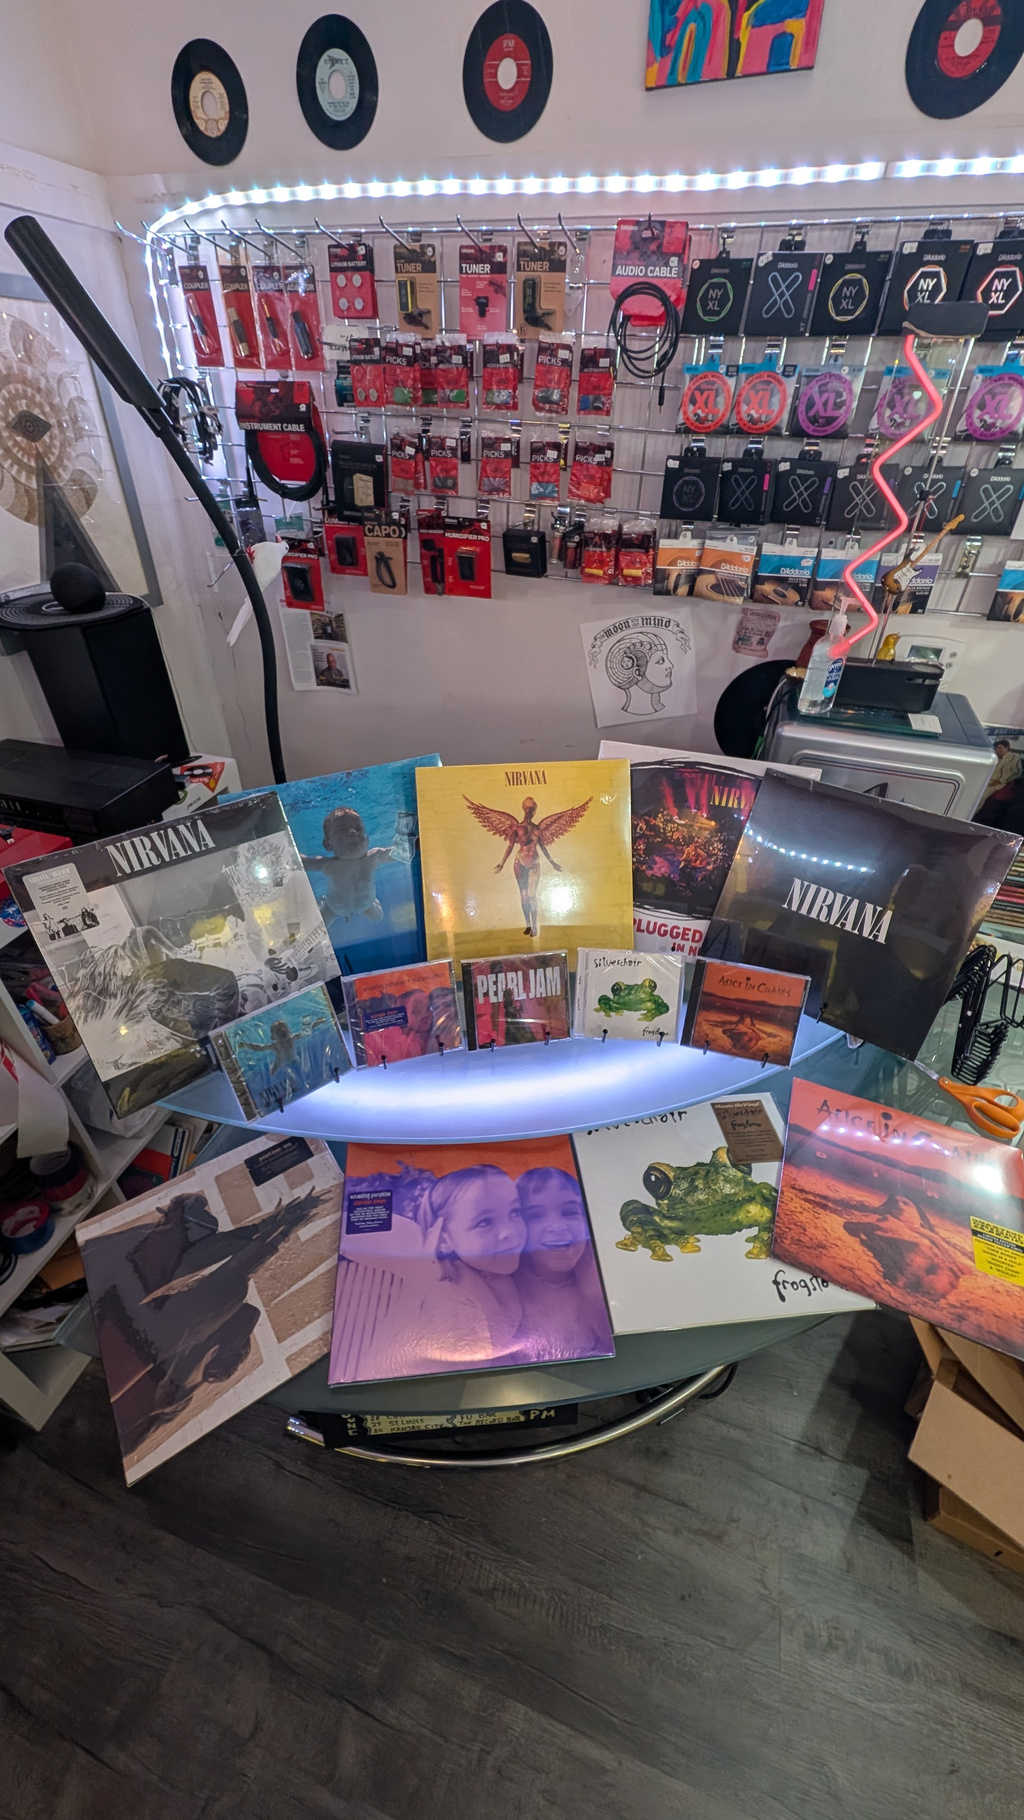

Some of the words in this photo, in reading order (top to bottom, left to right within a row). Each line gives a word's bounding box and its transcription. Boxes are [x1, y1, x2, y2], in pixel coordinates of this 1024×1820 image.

[396, 262, 422, 273] TUNER
[461, 264, 491, 273] TUNER
[520, 261, 550, 272] TUNER
[615, 265, 646, 276] AUDIO
[647, 266, 679, 278] CABLE
[184, 282, 209, 290] COUPLER
[224, 282, 248, 290] COUPLER
[918, 278, 938, 291] NY
[992, 278, 1012, 291] NY
[708, 288, 724, 299] NY
[842, 286, 859, 297] NY
[915, 292, 931, 303] XL
[988, 292, 1006, 304] XL
[707, 300, 720, 310] XL
[840, 298, 854, 309] XL
[385, 356, 407, 366] PICKS
[538, 355, 562, 366] PICKS
[691, 390, 721, 415] XL
[745, 390, 775, 415] XL
[808, 392, 843, 417] XL
[887, 394, 921, 420] XL
[976, 394, 1014, 420] XL
[240, 421, 282, 432] INSTRUMENT
[282, 422, 306, 432] CABLE
[391, 450, 410, 460] PICKS
[430, 449, 452, 458] PICKS
[483, 450, 505, 459] PICKS
[531, 454, 554, 463] PICKS
[575, 454, 598, 464] PICKS
[364, 524, 400, 538] CAPO
[444, 532, 478, 541] HUMIDIFIER
[720, 563, 748, 572] D'Addario
[780, 567, 810, 576] D'Addario
[604, 620, 631, 639] moon
[641, 617, 671, 629] mind
[505, 769, 547, 787] NIRVANA
[105, 819, 217, 877] NIRVANA
[782, 877, 895, 945] NIRVANA
[593, 956, 642, 969] silverchair
[476, 972, 527, 1004] PEARL
[528, 966, 561, 999] JAM
[529, 1409, 556, 1420] PM
[400, 1418, 425, 1426] LOUIS
[390, 1425, 421, 1433] KANSAS
